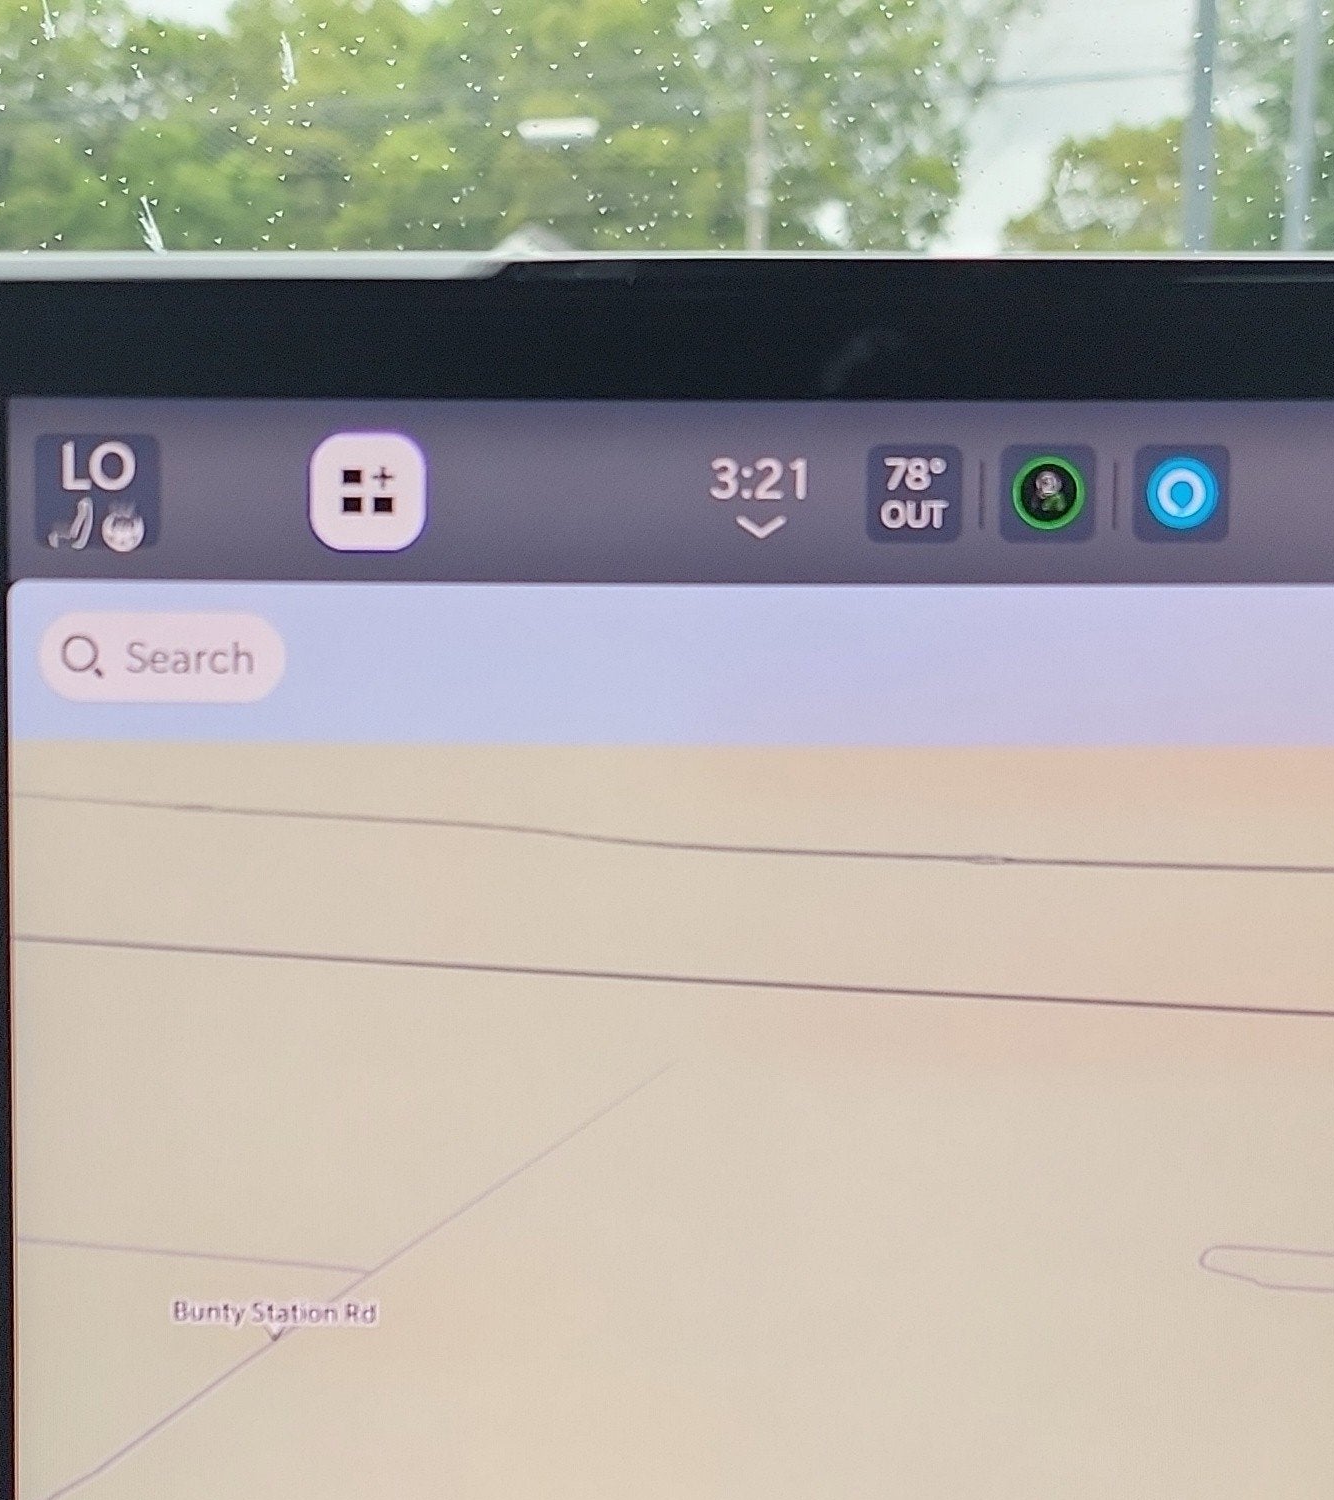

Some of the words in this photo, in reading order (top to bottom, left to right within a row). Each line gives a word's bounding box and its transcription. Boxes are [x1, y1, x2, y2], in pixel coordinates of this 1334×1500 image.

[61, 440, 137, 492] LO
[709, 456, 809, 500] 3:21
[883, 456, 947, 491] 78°
[880, 499, 949, 529] OUT
[125, 640, 255, 676] Search
[174, 1301, 246, 1327] Bunty
[252, 1302, 338, 1323] Station
[347, 1303, 377, 1323] Rd
